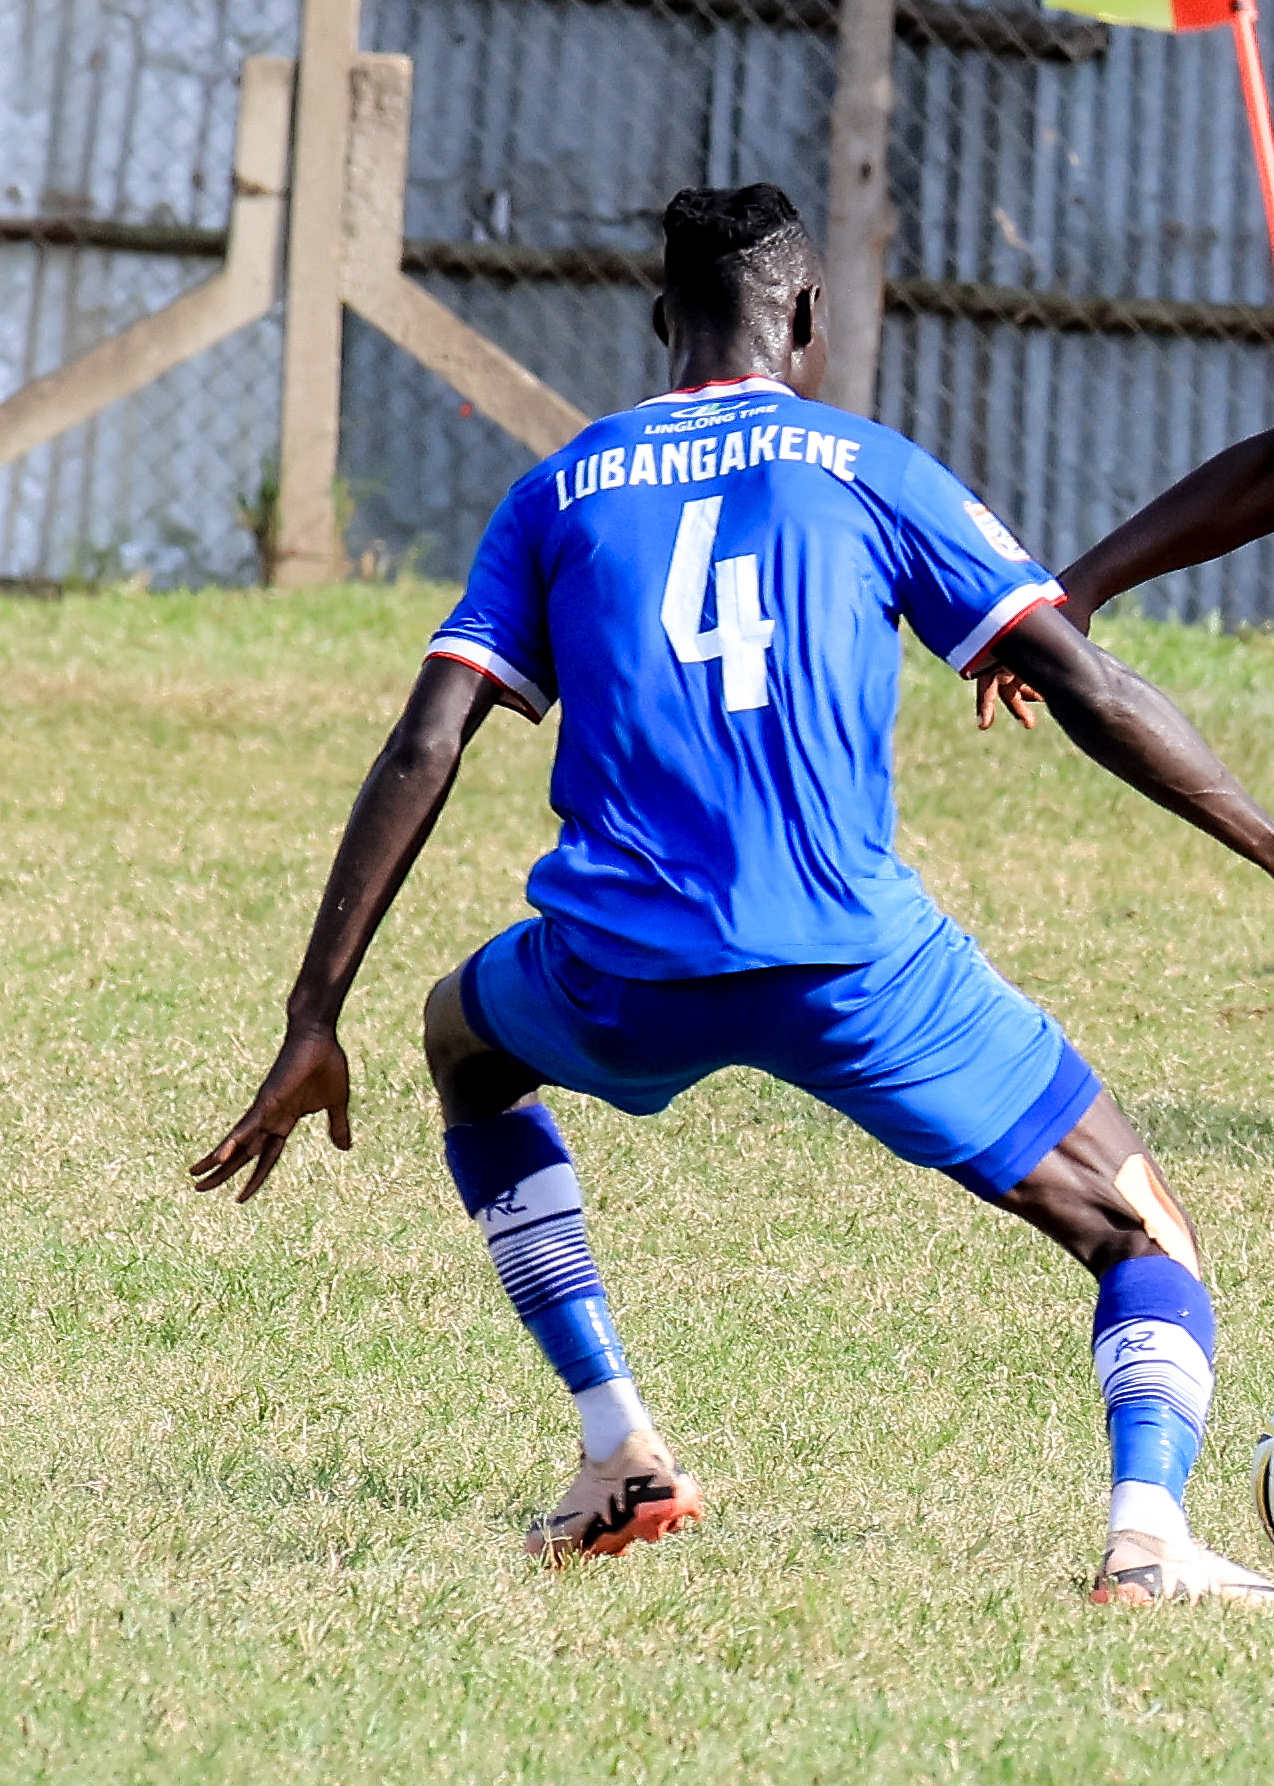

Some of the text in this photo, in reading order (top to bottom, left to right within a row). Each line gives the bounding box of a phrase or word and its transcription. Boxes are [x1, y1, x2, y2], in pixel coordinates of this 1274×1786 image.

[644, 405, 779, 434] LINGLONG TIRE
[556, 427, 861, 511] LUBANGAKENE
[661, 495, 776, 712] 4
